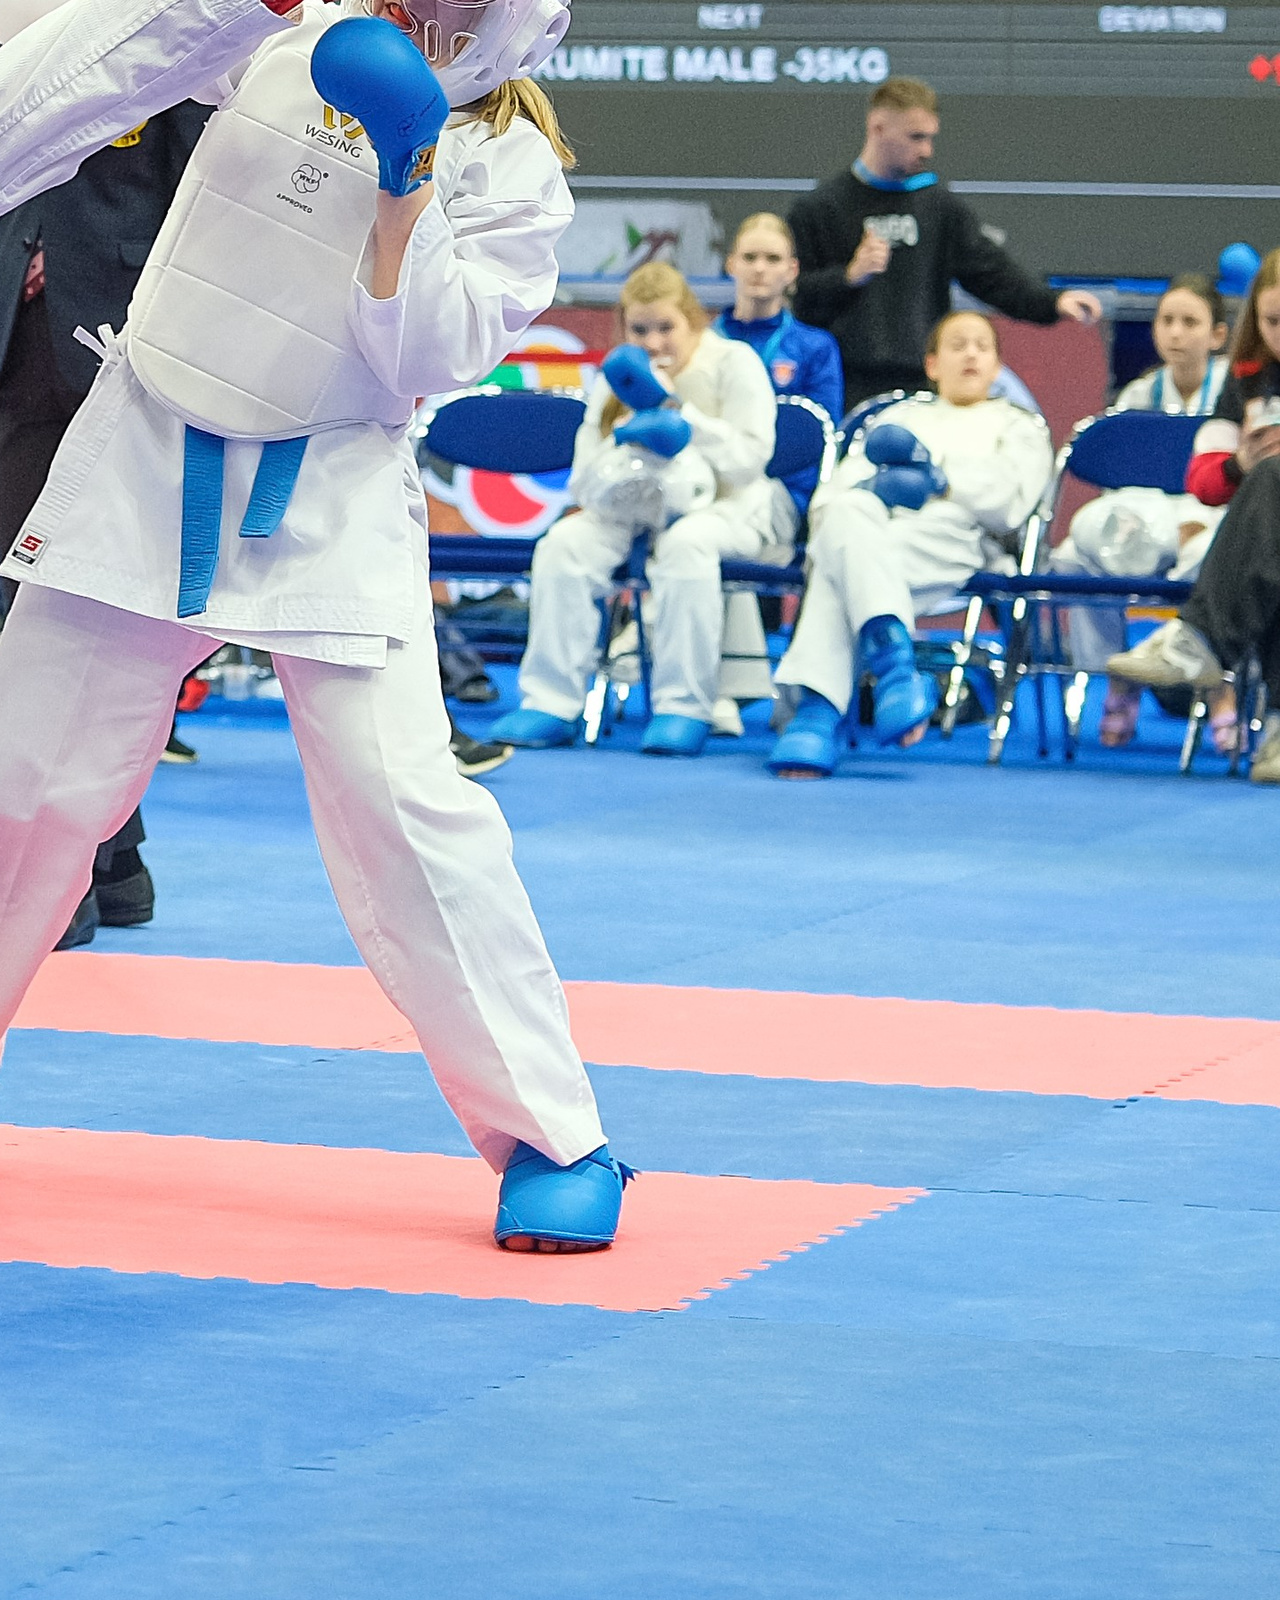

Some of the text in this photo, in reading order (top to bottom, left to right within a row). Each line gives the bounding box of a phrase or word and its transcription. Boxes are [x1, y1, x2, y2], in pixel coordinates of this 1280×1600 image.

[673, 46, 777, 81] MALE
[305, 124, 363, 158] WESING
[276, 193, 313, 214] APPROVED
